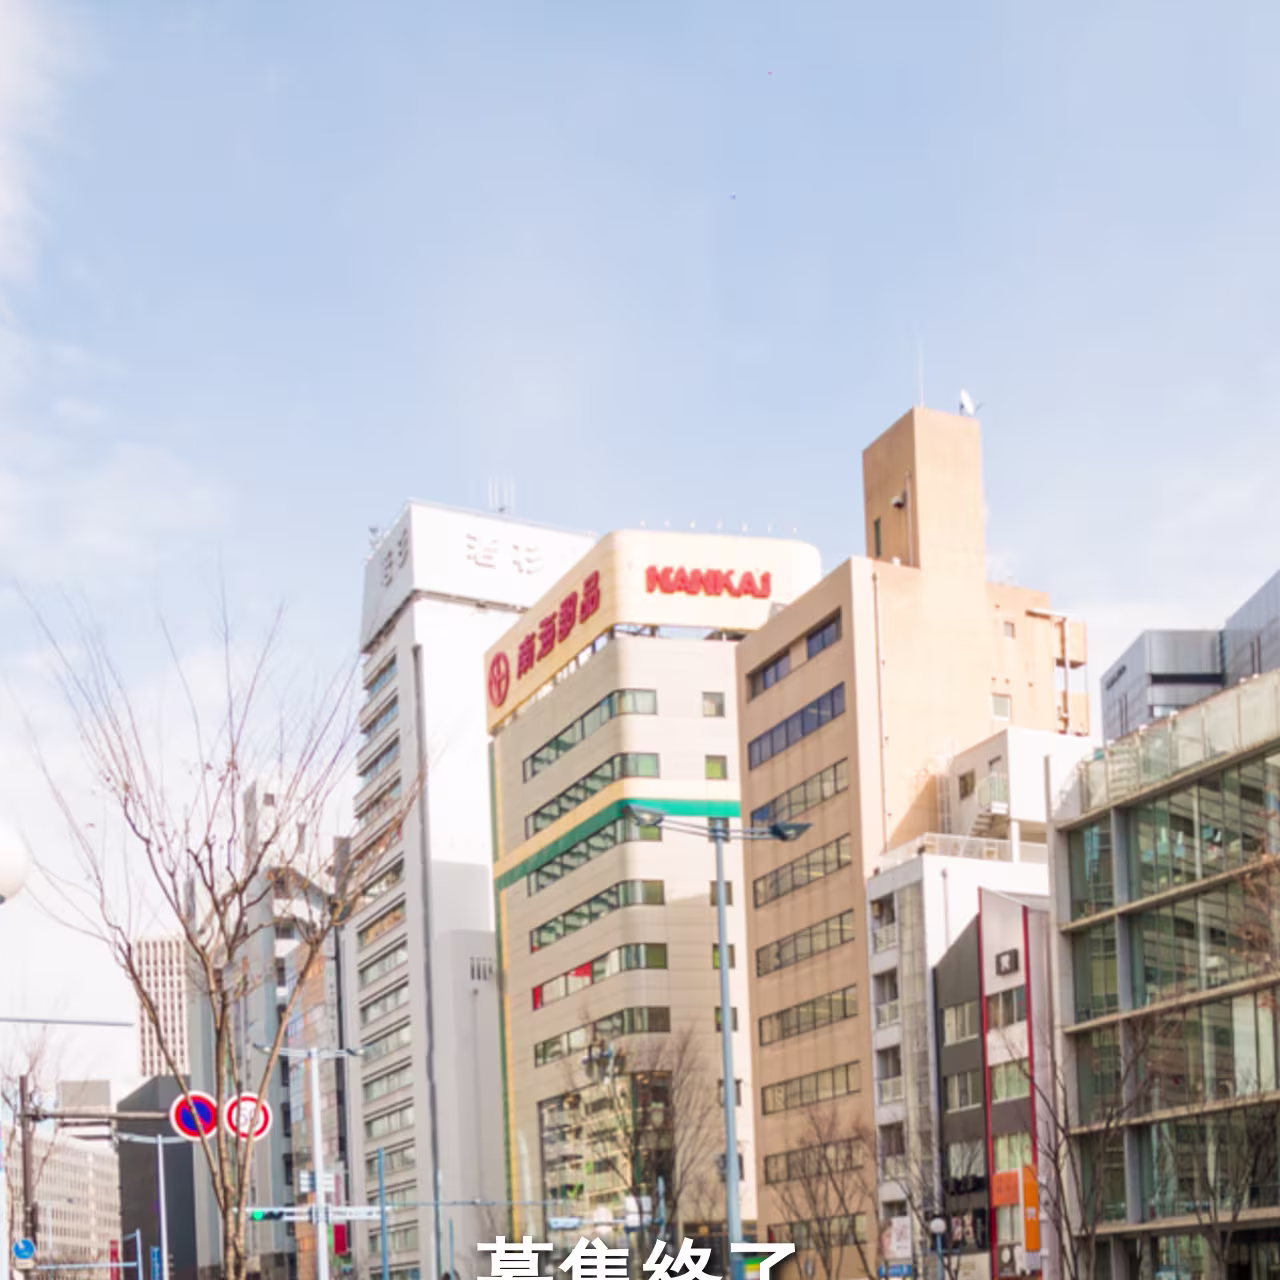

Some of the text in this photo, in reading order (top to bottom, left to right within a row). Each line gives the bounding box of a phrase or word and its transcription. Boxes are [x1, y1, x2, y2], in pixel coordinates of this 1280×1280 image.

[646, 566, 772, 598] NANKAI
[516, 570, 600, 680] 南海部品
